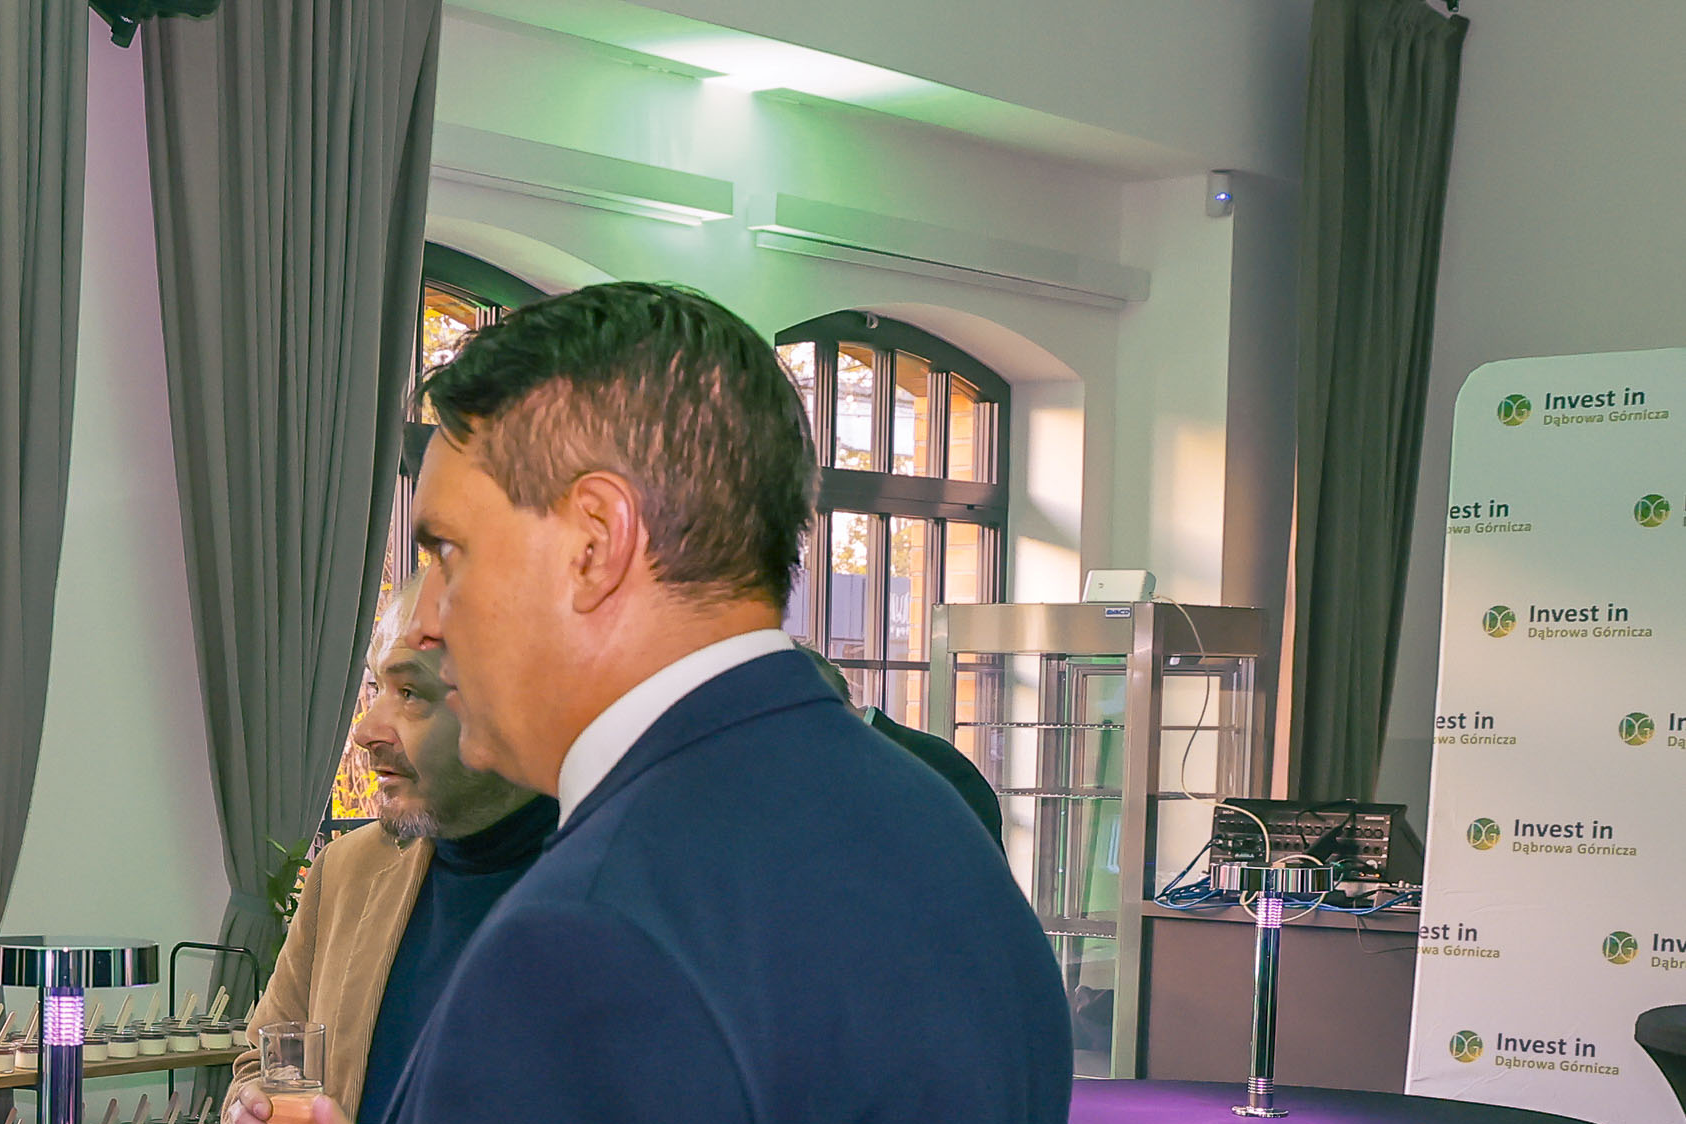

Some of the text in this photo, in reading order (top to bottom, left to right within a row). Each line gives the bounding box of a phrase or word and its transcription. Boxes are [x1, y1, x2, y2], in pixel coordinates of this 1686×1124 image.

[1545, 387, 1646, 411] Invest in
[1543, 408, 1670, 427] Dąbrowa Górnicza
[1489, 499, 1510, 518] in
[1474, 521, 1533, 533] Górnicza
[1529, 602, 1629, 623] Invest in
[1528, 625, 1653, 640] Dąbrowa Górnicza
[1474, 711, 1494, 729] in
[1460, 733, 1517, 745] Górnicza
[1514, 819, 1613, 839] Invest in
[1512, 841, 1637, 856] Dąbrowa Górnicza
[1458, 922, 1477, 941] in
[1443, 945, 1500, 958] Górnicza
[1497, 1033, 1596, 1058] Invest in
[1495, 1056, 1620, 1076] Dąbrowa Górnicza
